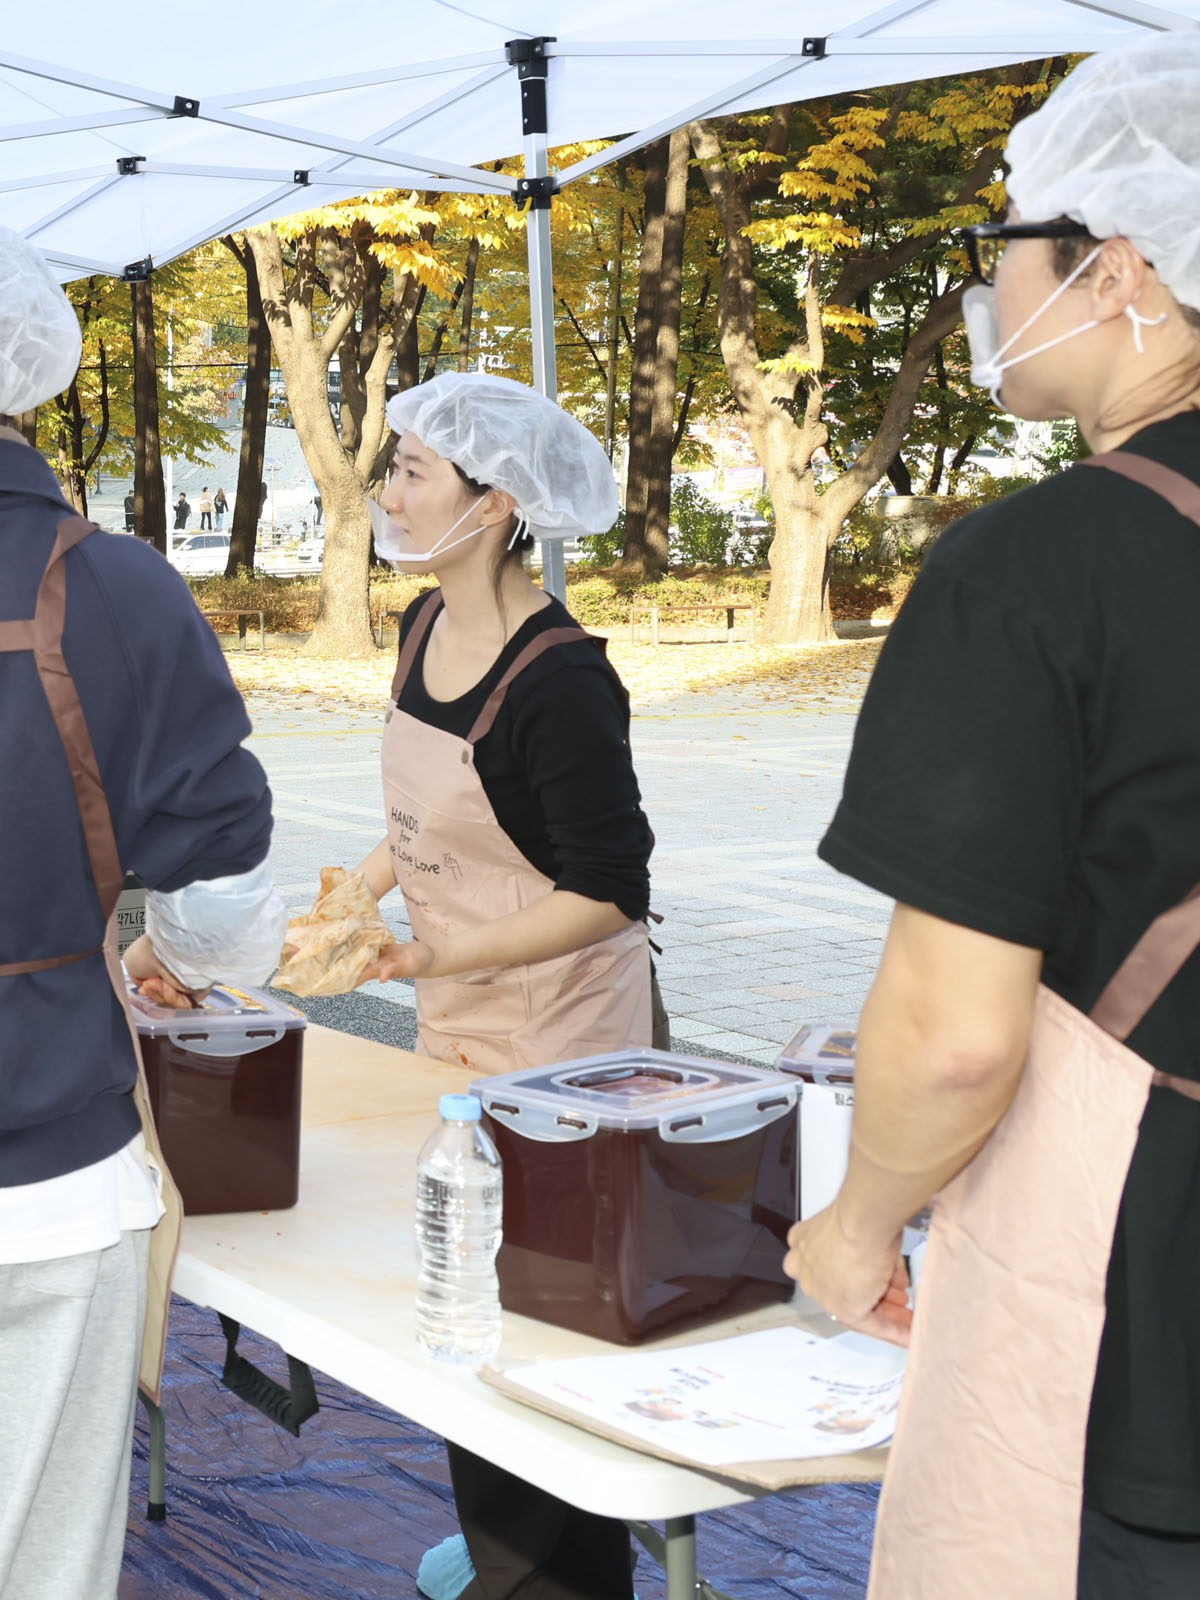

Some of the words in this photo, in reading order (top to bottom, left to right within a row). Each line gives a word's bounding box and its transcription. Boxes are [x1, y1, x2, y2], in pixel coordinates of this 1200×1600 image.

[391, 807, 419, 835] HANDS
[399, 830, 412, 845] for
[414, 857, 441, 875] Love
